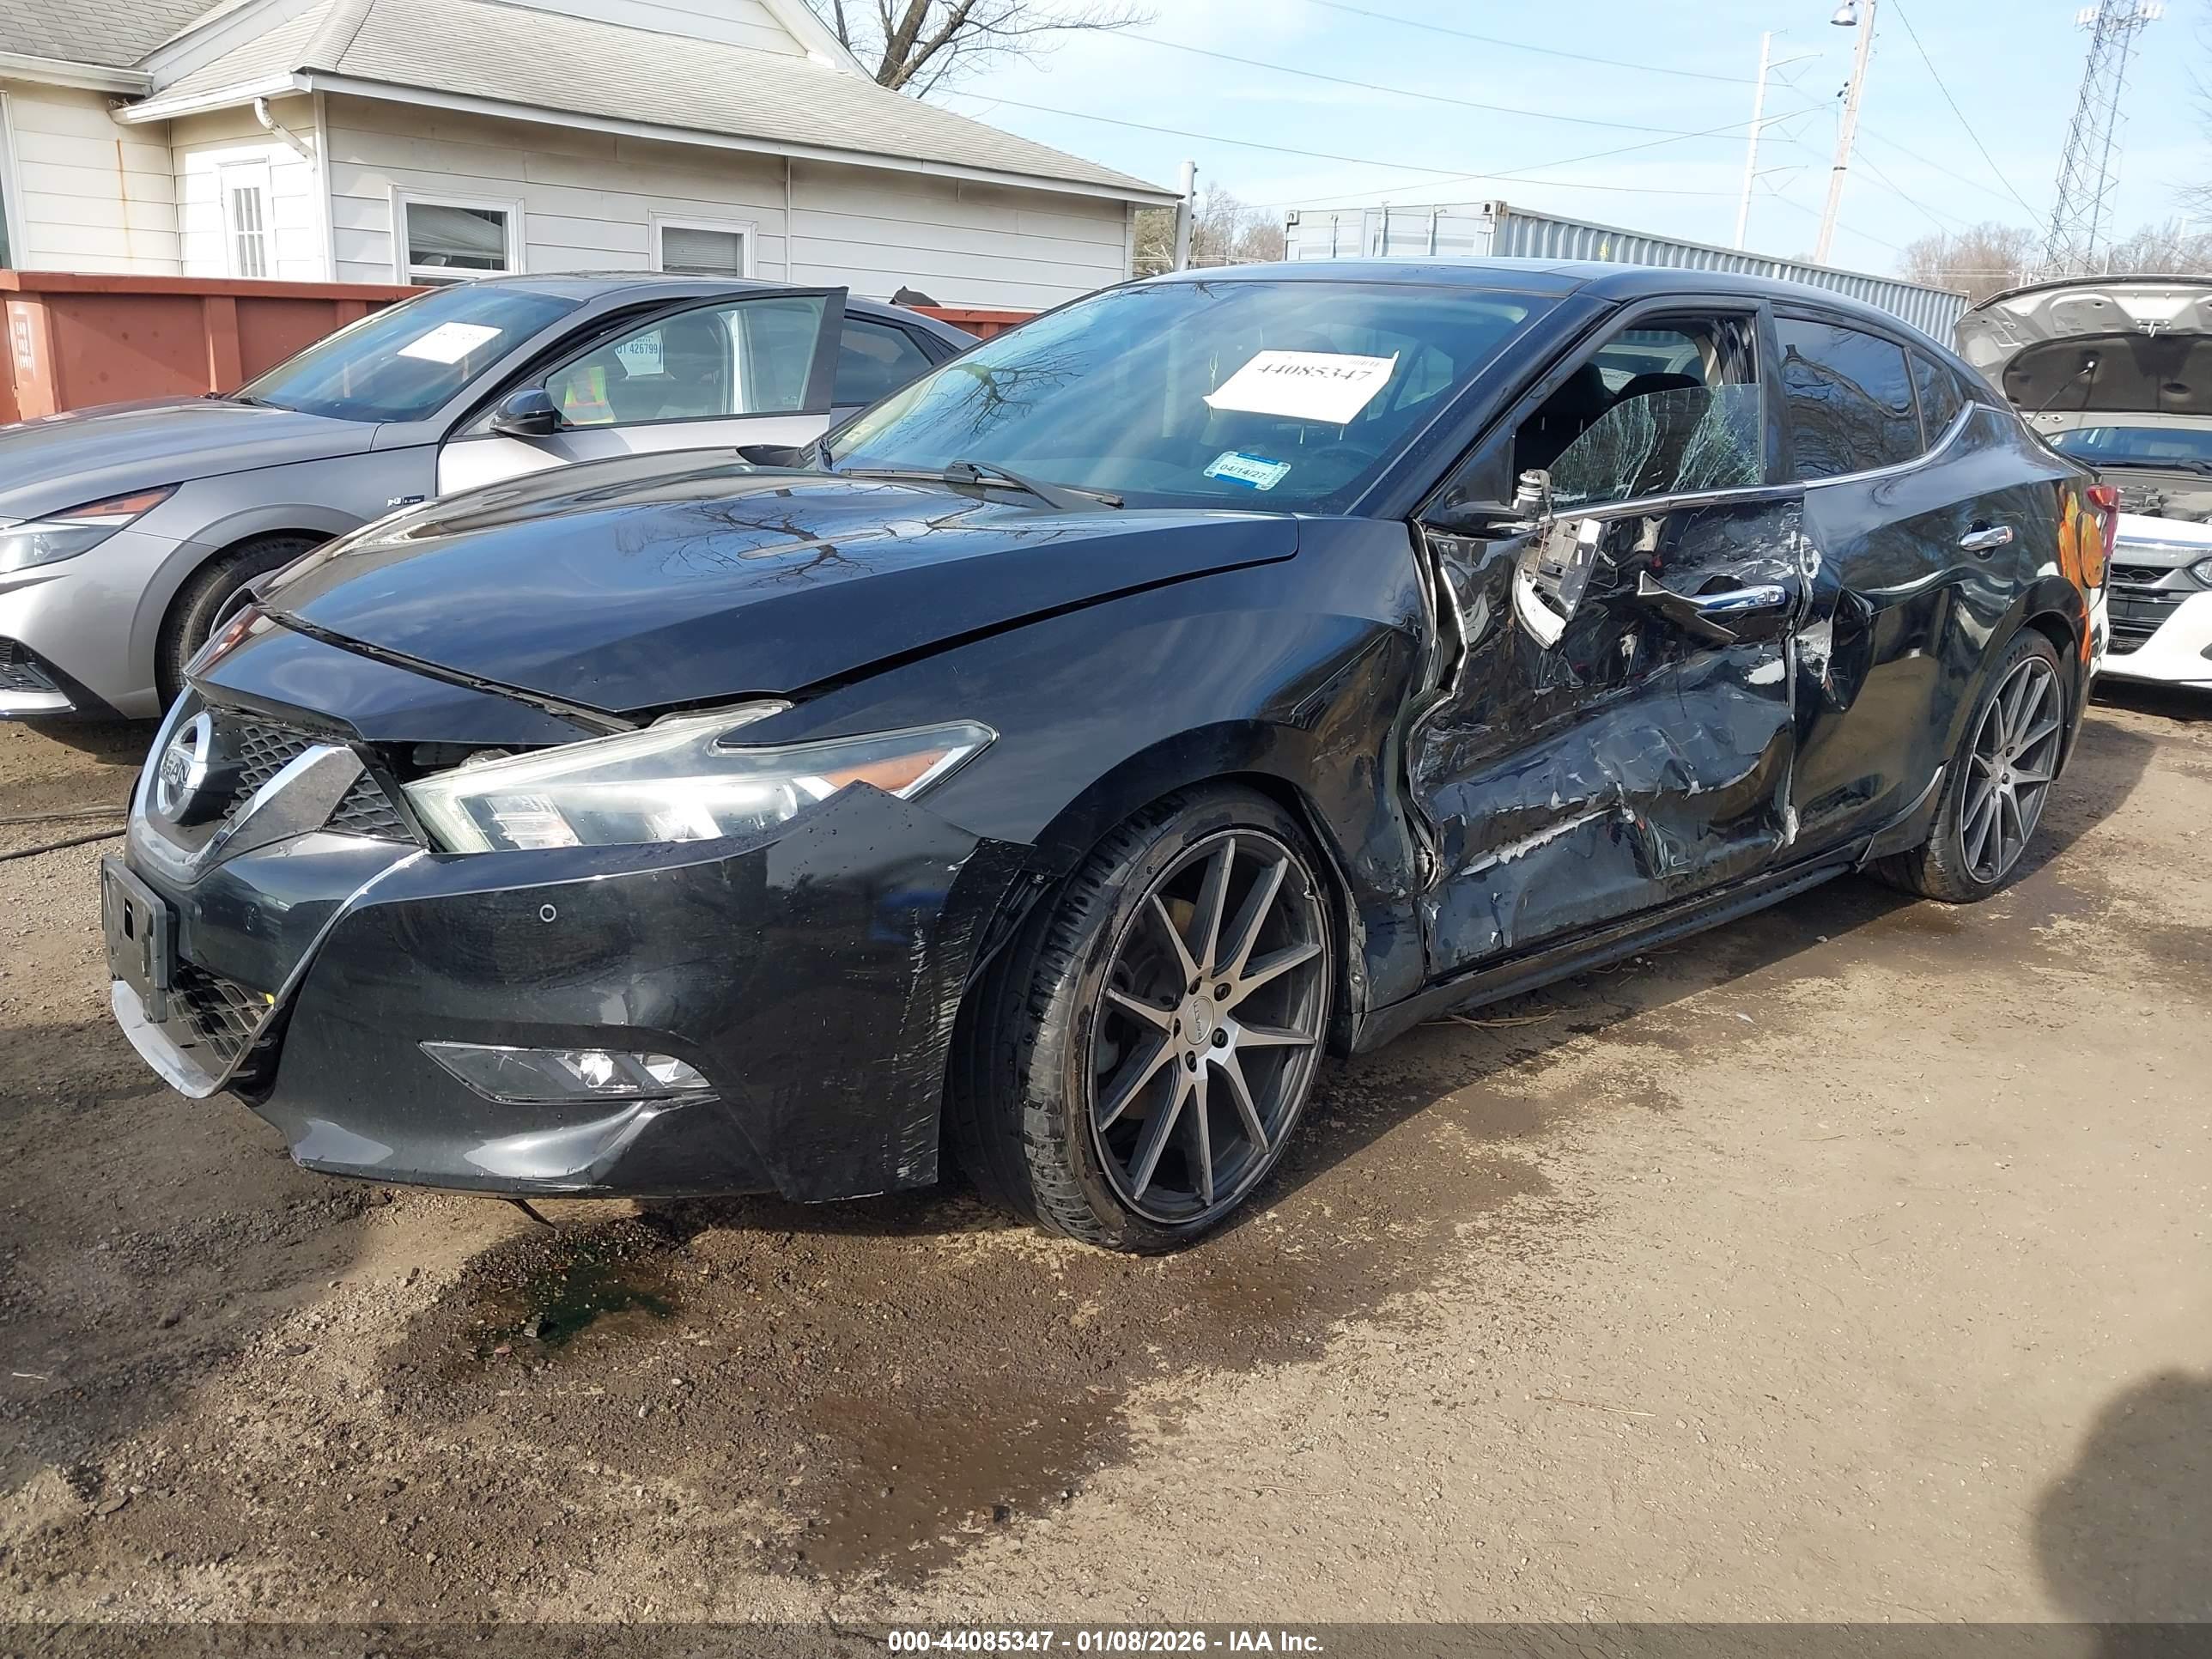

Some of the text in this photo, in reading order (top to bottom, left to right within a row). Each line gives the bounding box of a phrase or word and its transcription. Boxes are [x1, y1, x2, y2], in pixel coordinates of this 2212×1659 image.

[629, 343, 658, 354] 426799
[1257, 363, 1373, 381] 44085347
[1220, 465, 1266, 479] 04/14/27
